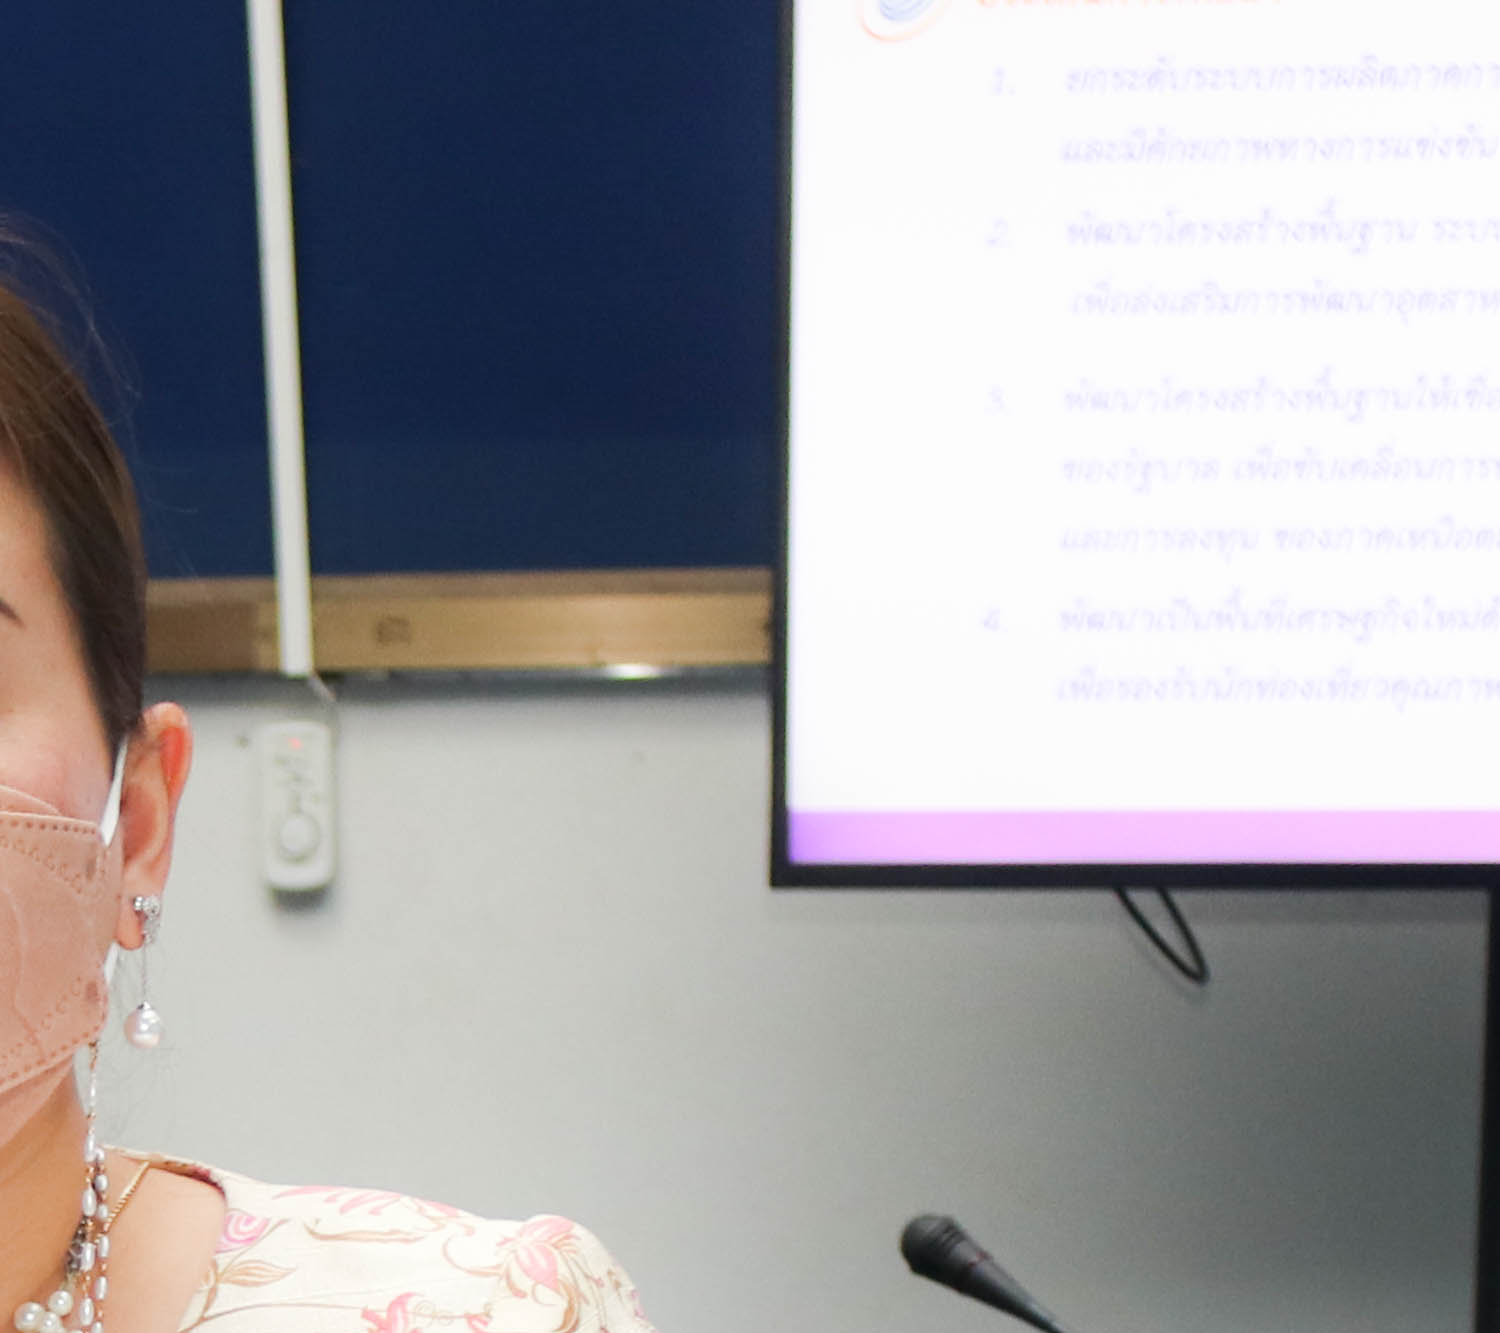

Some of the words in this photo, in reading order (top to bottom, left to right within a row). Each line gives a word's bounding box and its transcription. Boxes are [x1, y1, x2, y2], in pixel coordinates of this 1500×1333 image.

[1064, 194, 1417, 254] พัฒนาโครงสร้างพื้นฐาน
